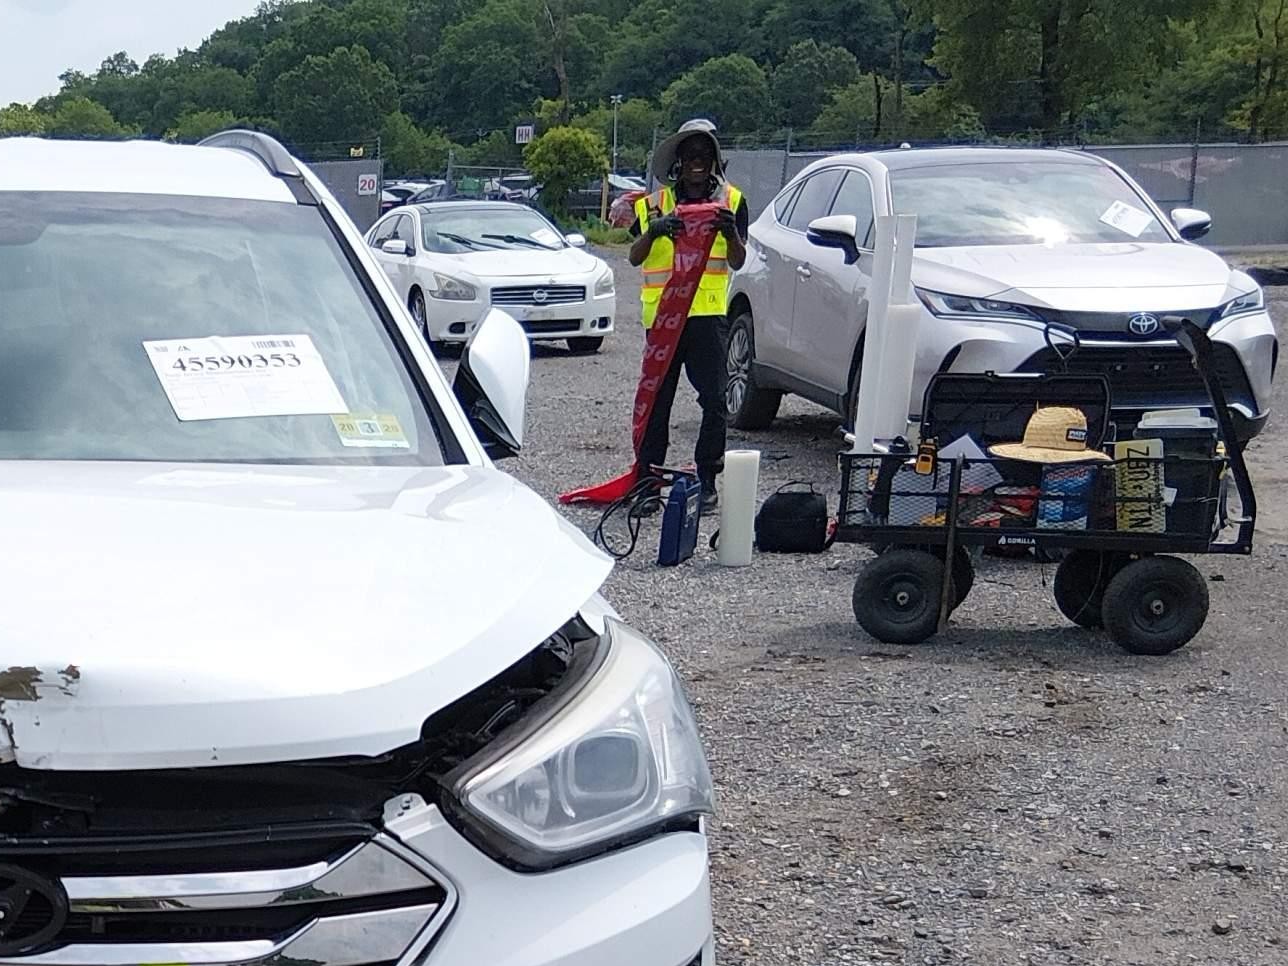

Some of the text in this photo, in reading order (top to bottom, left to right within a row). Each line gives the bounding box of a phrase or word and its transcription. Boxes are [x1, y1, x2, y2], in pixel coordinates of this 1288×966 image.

[517, 127, 530, 142] HH
[359, 179, 376, 191] 20
[172, 352, 301, 372] 45590353
[1007, 537, 1036, 545] GORILLA
